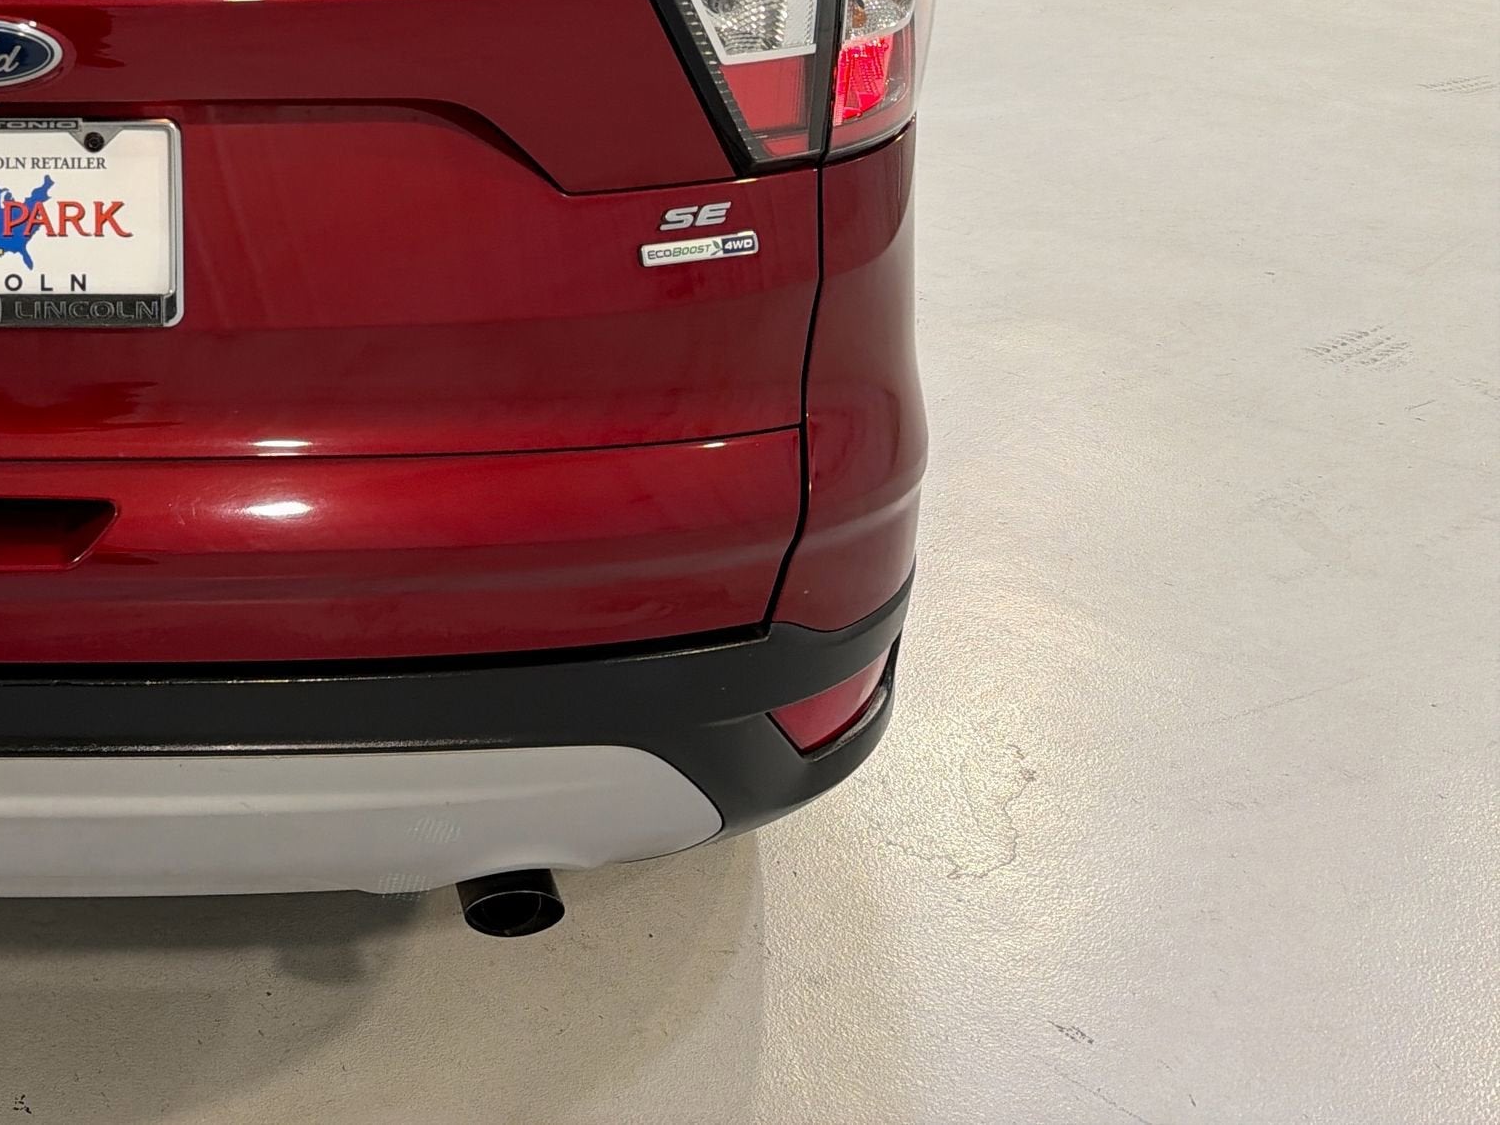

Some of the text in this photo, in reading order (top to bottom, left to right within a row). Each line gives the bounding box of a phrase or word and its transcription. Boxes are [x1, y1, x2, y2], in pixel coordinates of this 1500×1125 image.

[31, 156, 107, 170] RETAILER
[3, 200, 134, 238] PARK
[660, 201, 732, 231] SE
[724, 238, 754, 251] 4WD
[14, 300, 159, 320] LINCOLN
